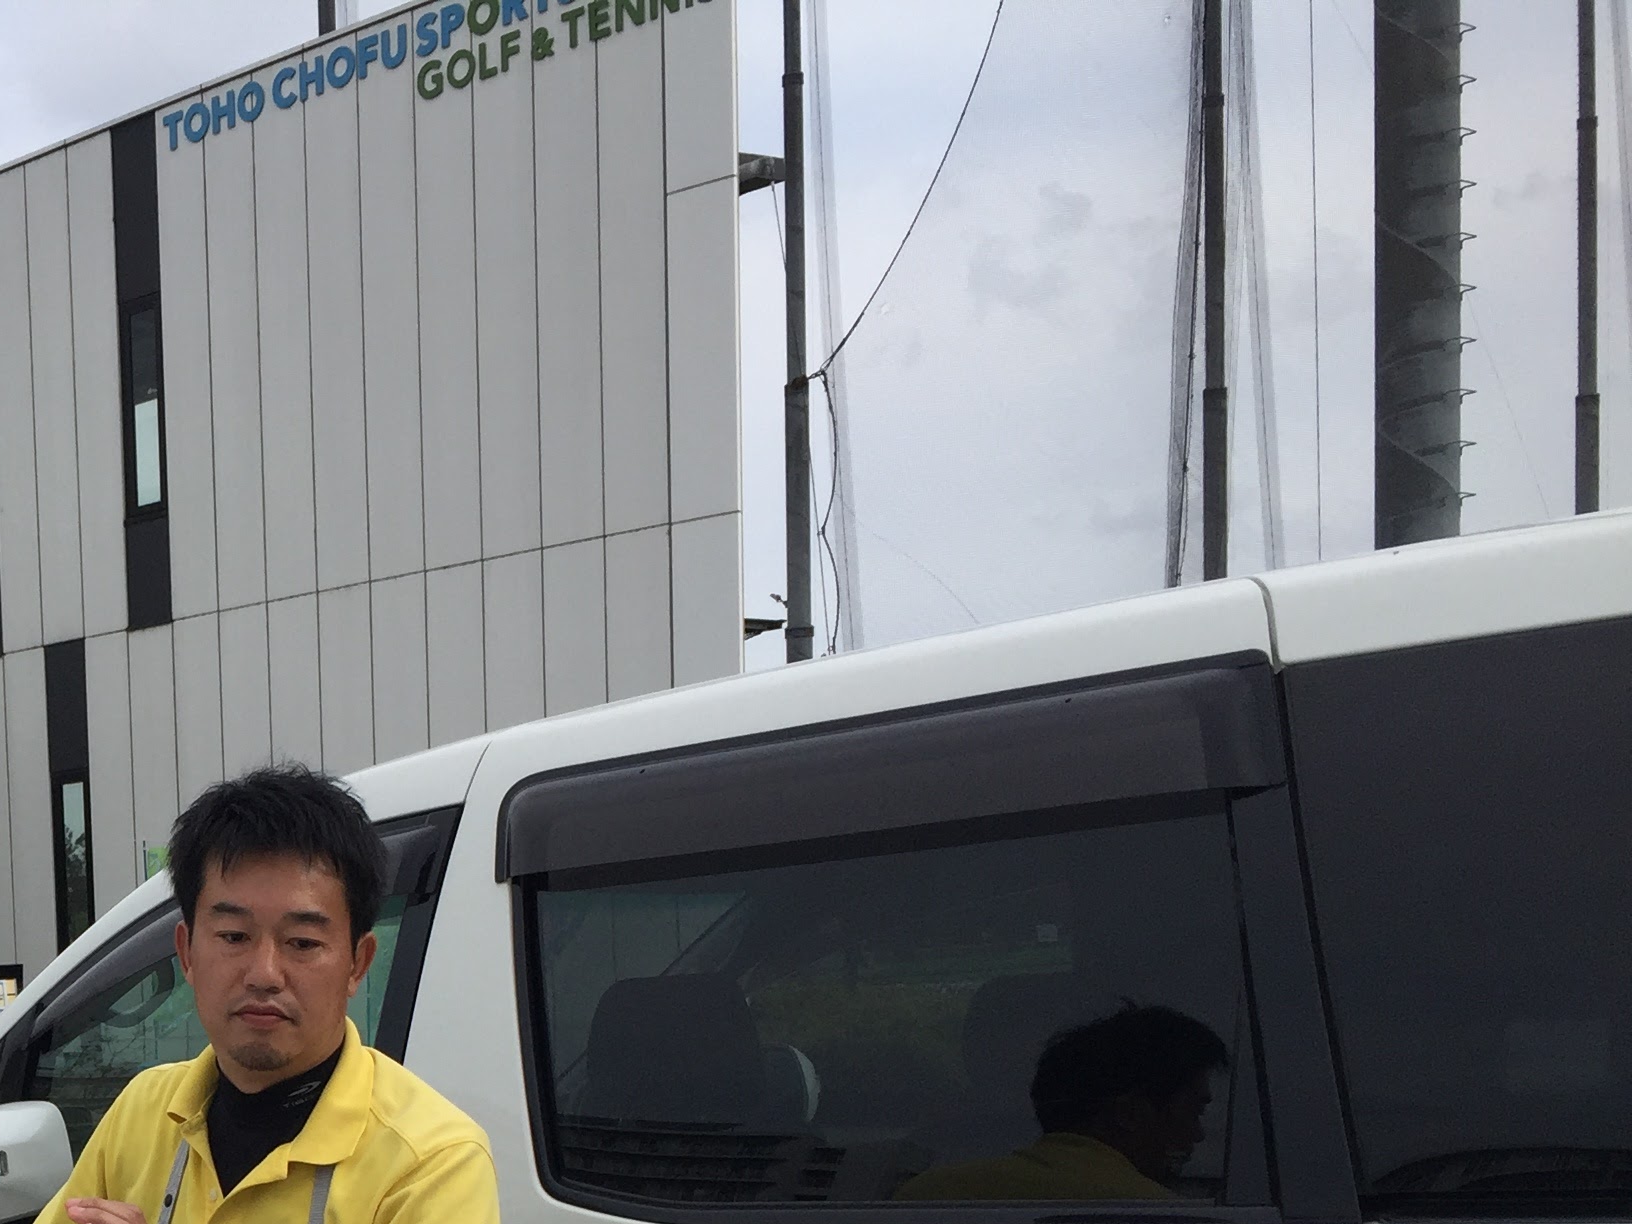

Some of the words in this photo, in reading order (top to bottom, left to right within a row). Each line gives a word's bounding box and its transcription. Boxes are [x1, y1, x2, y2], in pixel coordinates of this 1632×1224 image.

[163, 80, 265, 151] TOHO
[272, 23, 408, 110] CHOFU
[415, 0, 575, 57] SPOR
[417, 28, 521, 101] GOLF
[531, 26, 555, 61] &
